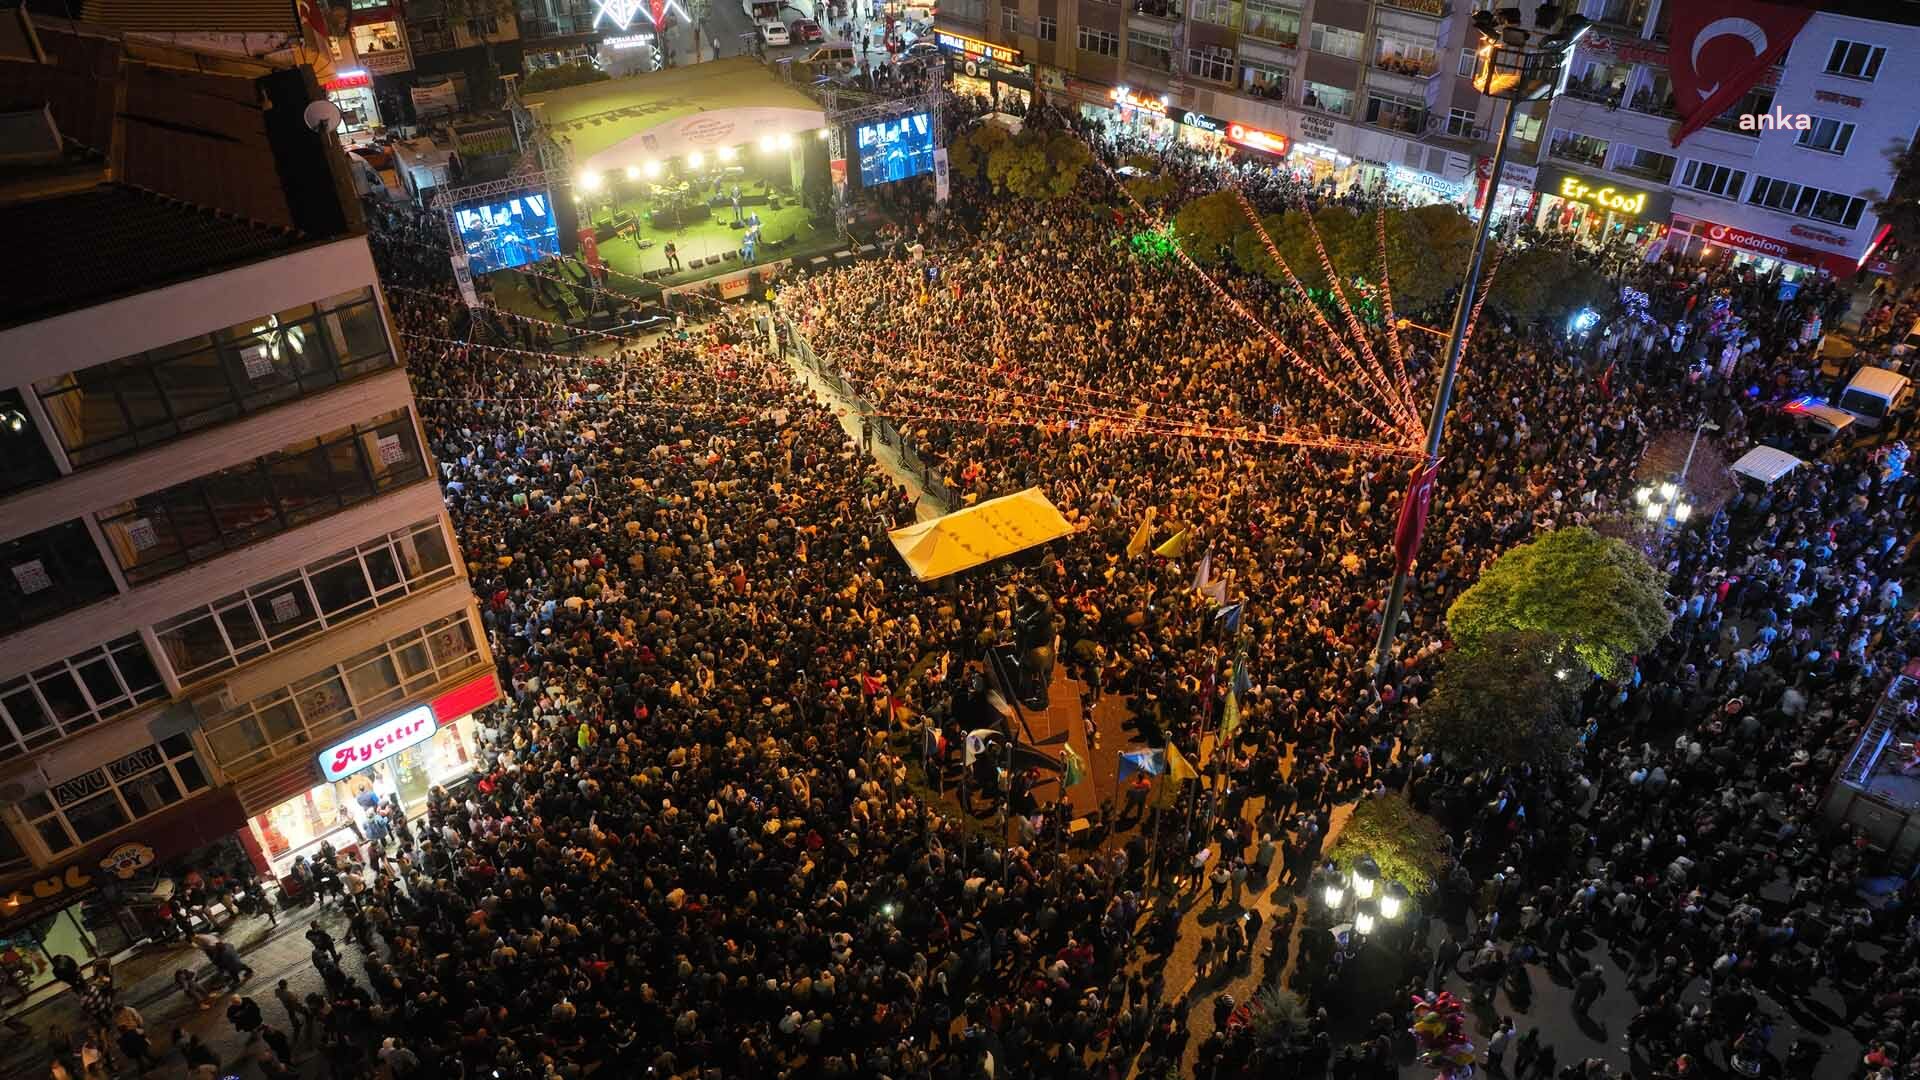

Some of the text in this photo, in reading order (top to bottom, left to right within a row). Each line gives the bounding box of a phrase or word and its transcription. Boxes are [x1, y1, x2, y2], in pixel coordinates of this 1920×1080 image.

[993, 48, 1012, 62] CAFE
[1562, 177, 1646, 213] Er-Cool
[1730, 232, 1788, 254] vodafone
[331, 719, 425, 773] Ayçıtır
